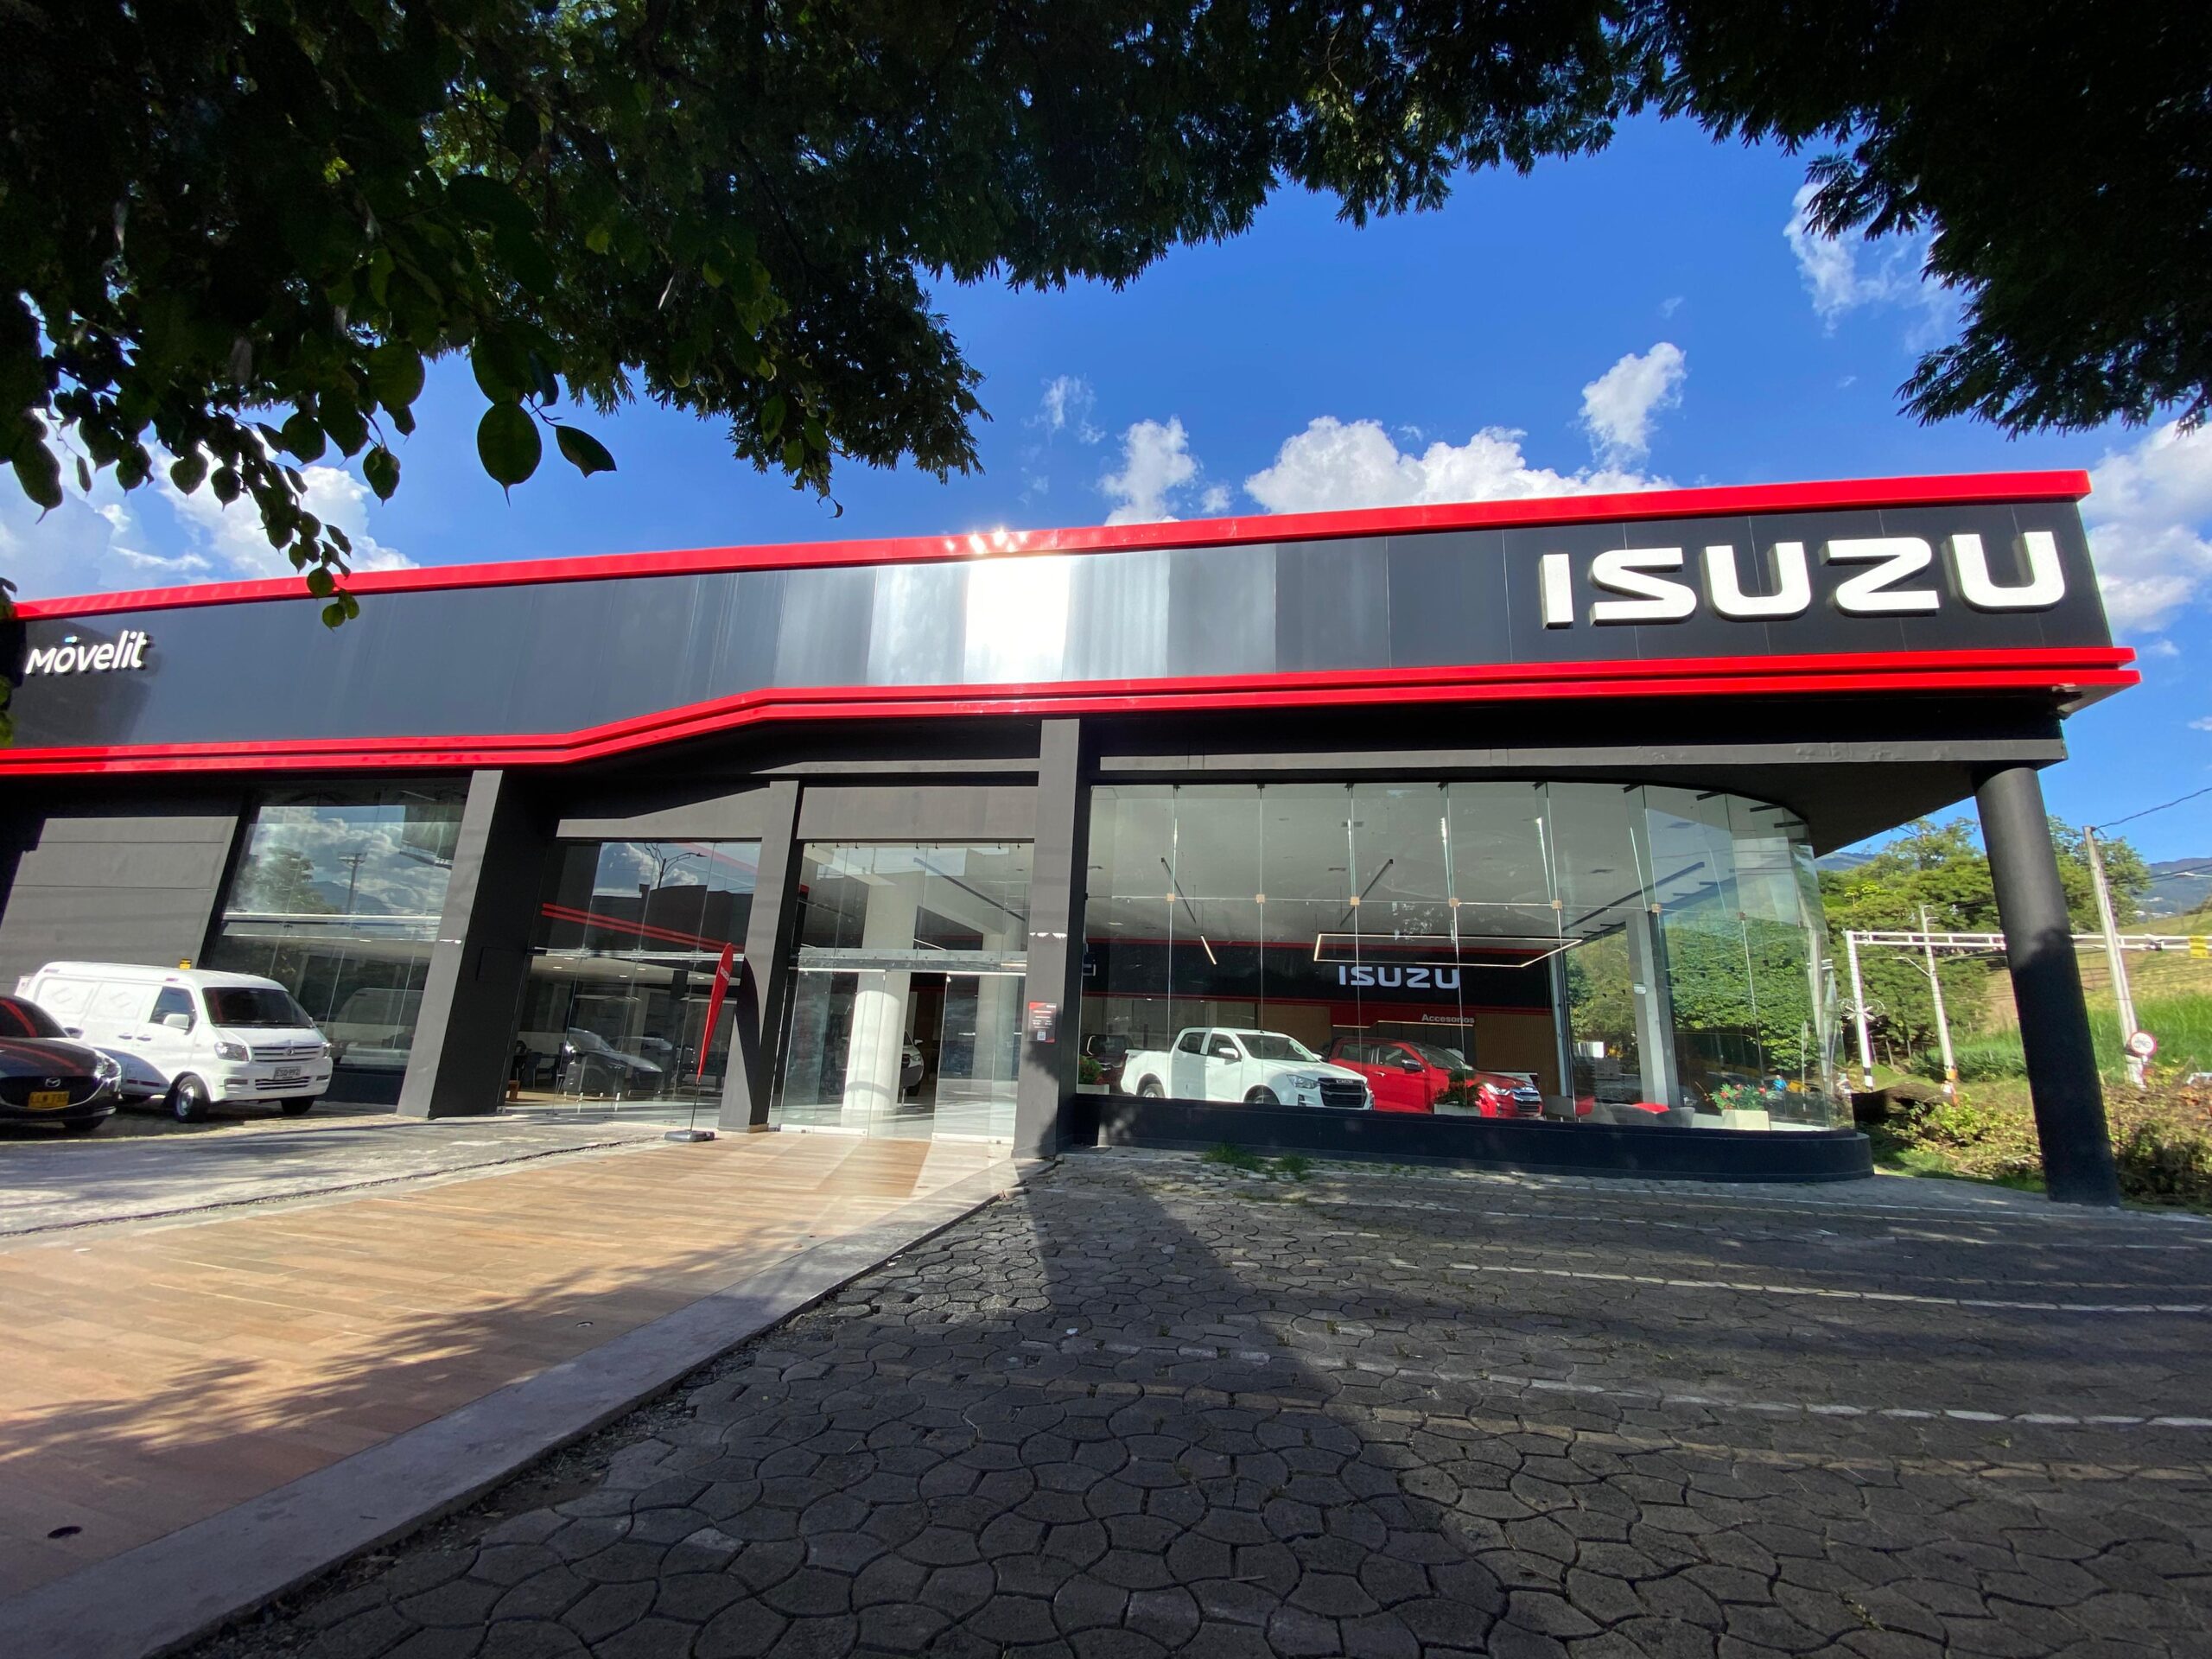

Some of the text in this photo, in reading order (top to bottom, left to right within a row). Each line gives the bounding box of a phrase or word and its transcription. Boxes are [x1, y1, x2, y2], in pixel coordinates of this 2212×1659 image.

[1541, 530, 2066, 629] ISUZU
[1338, 964, 1460, 989] ISUZU
[1421, 1014, 1475, 1024] Accesorios
